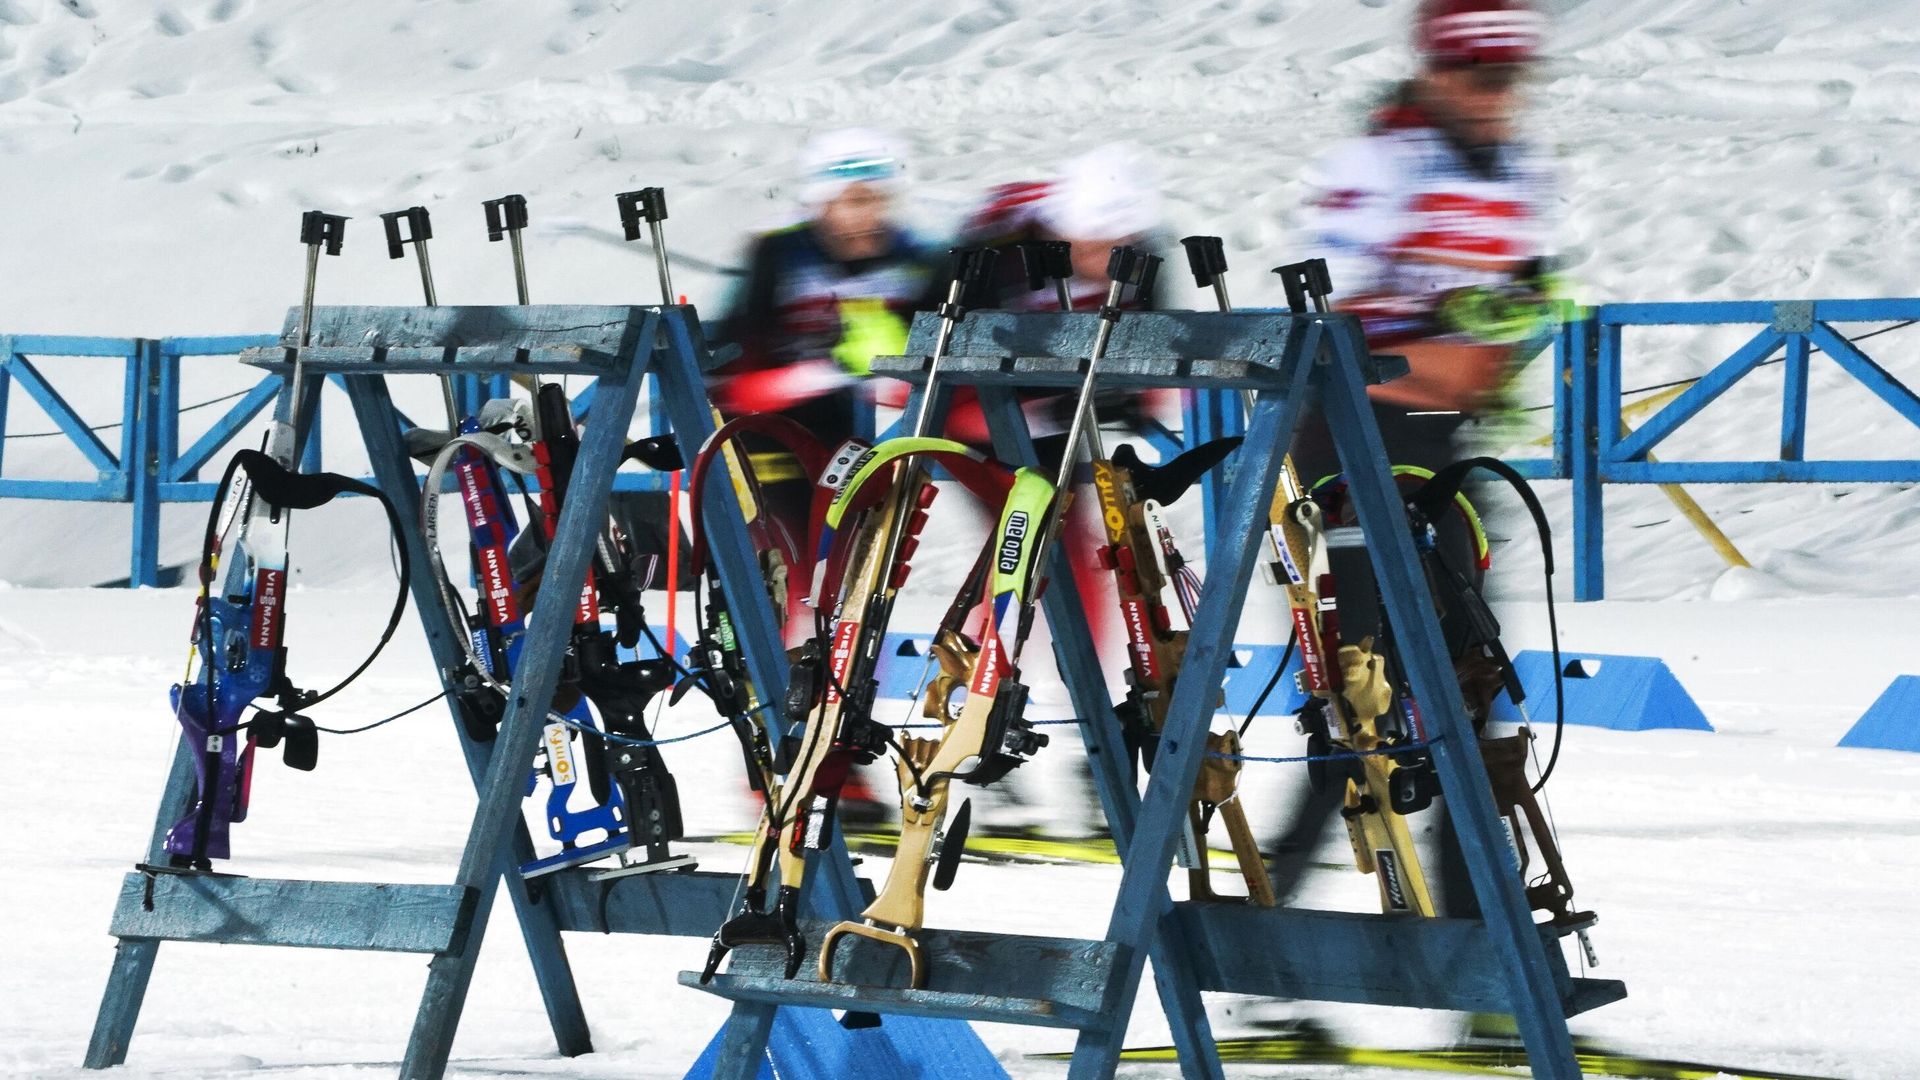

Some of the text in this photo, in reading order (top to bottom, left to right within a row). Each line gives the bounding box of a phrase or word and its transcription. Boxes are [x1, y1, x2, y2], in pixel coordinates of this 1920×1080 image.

[428, 493, 439, 538] LARSEN
[1000, 515, 1026, 570] meopta
[827, 623, 853, 701] VIESSMAN
[549, 726, 570, 783] somfy
